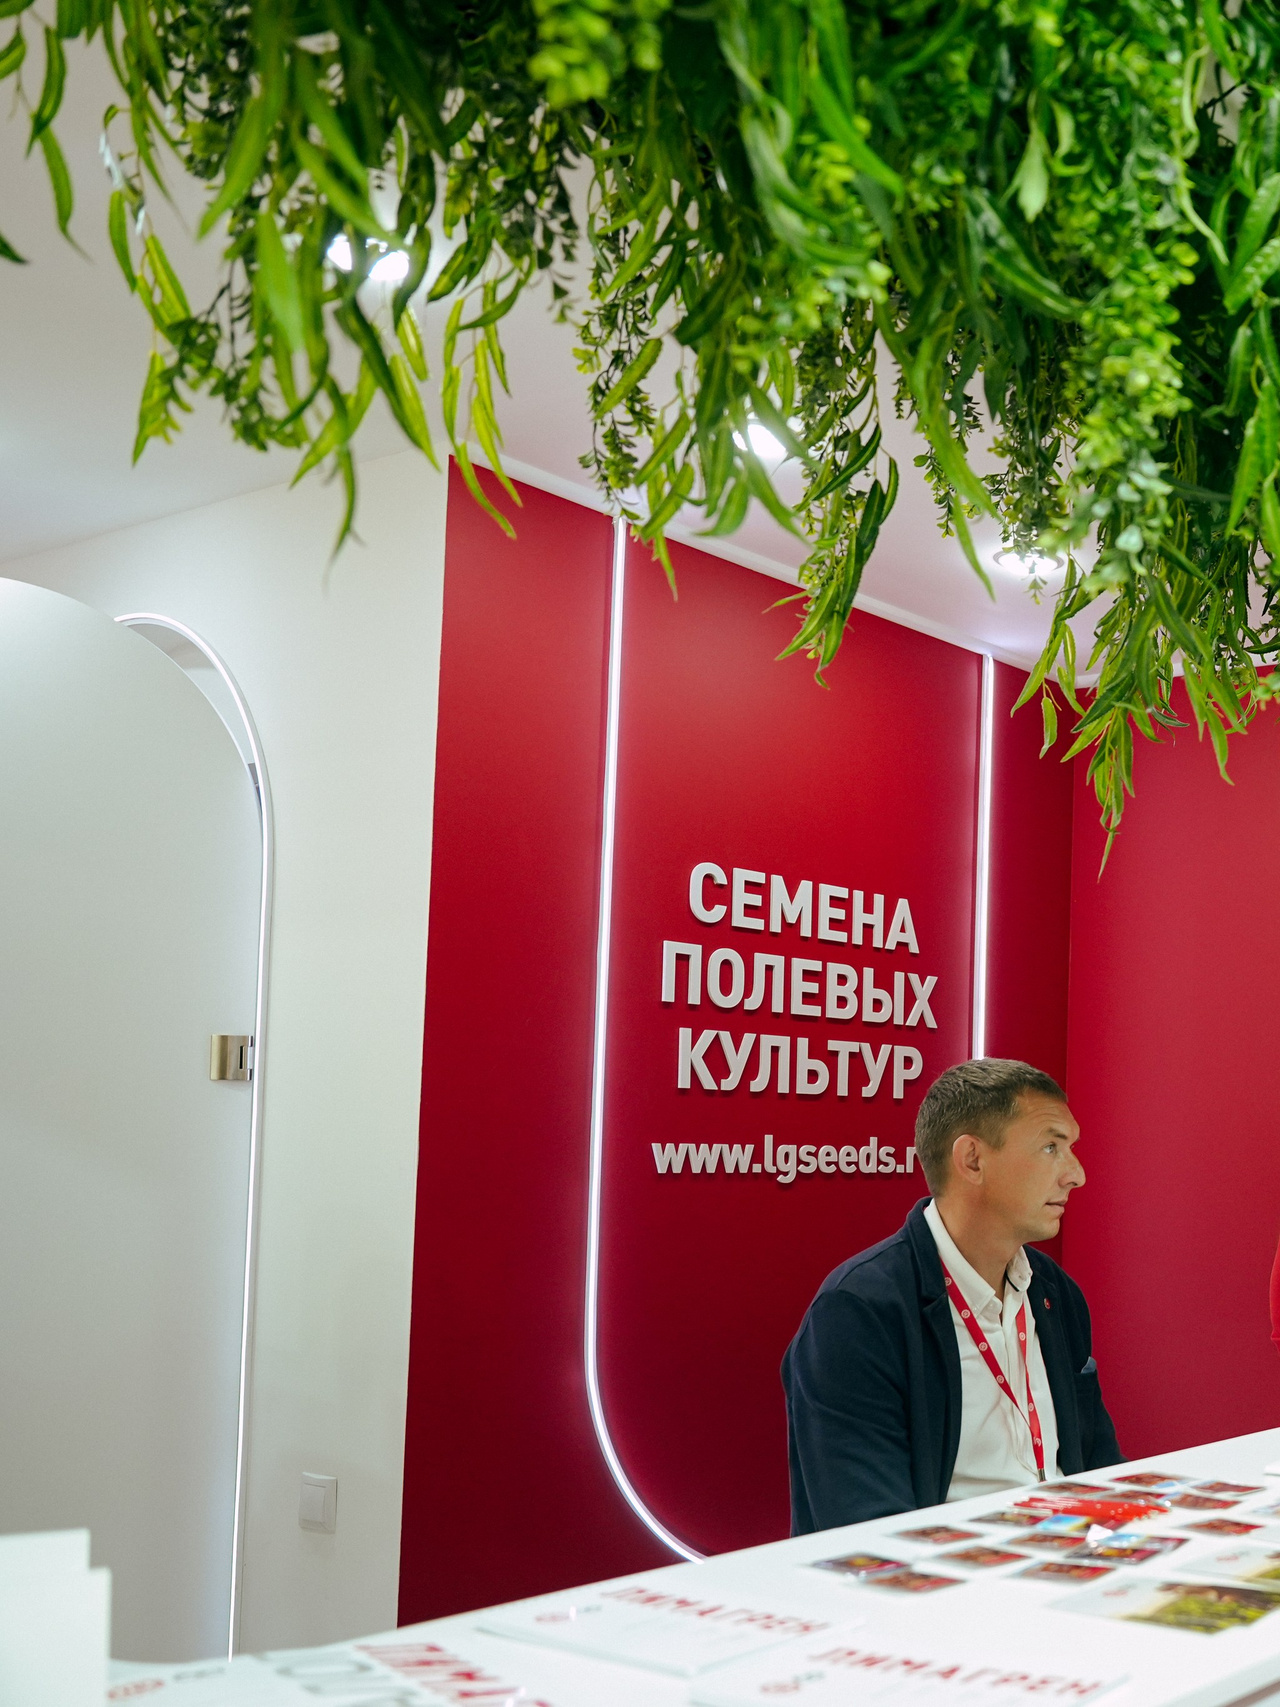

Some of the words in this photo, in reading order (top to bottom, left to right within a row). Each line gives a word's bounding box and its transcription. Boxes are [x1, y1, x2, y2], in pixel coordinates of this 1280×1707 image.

[689, 862, 920, 954] СЕМЕНА
[661, 940, 938, 1029] ПОЛЕВЫХ
[677, 1027, 923, 1099] КУЛЬТУР
[651, 1134, 918, 1184] www.lgseeds.r
